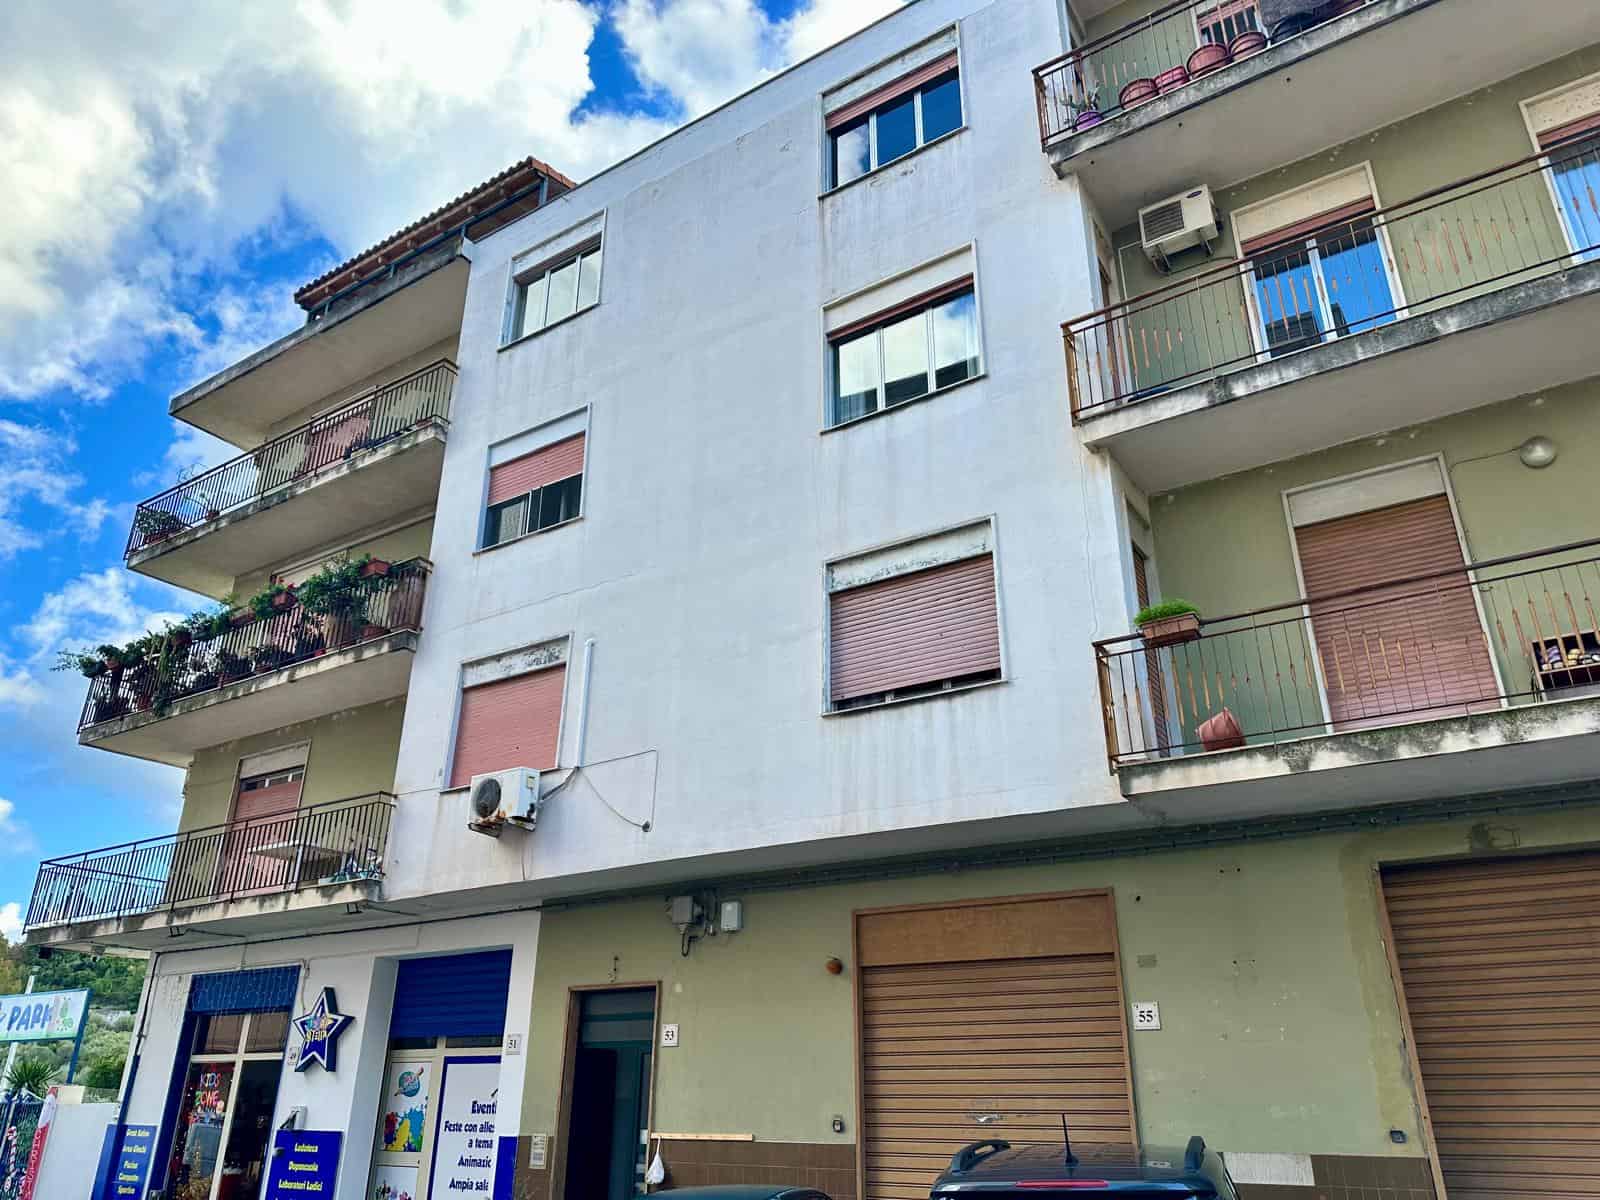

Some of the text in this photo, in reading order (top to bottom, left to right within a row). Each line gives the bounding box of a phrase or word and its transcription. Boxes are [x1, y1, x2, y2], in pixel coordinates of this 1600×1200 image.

[1139, 1010, 1153, 1023] 55
[664, 1030, 674, 1041] 53
[444, 1120, 462, 1132] Feste
[464, 1123, 477, 1132] con
[468, 1139, 473, 1148] a
[449, 1177, 473, 1192] Ampia
